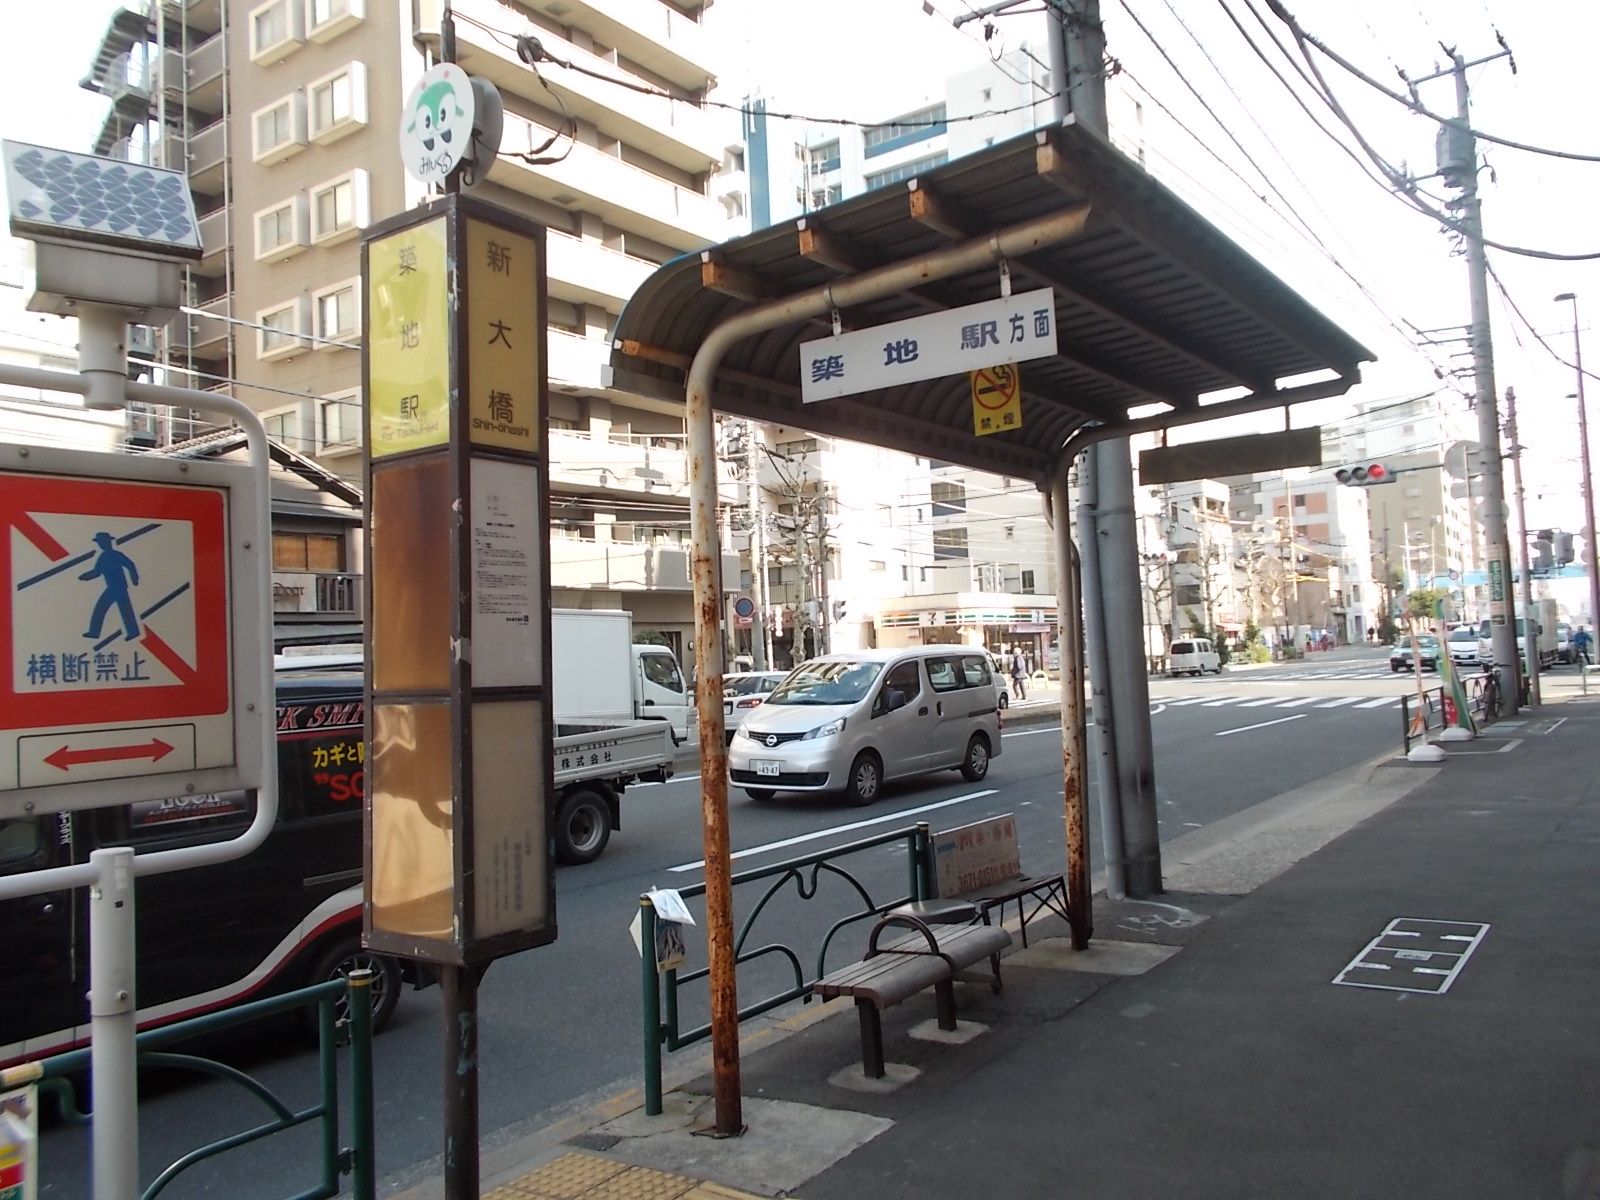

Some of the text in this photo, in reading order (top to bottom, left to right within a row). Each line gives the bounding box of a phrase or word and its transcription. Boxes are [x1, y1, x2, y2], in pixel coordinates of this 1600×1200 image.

[486, 239, 514, 424] 新大橋
[980, 411, 1015, 431] 禁煙
[26, 650, 151, 686] 横断禁止
[561, 750, 612, 770] 株式会社
